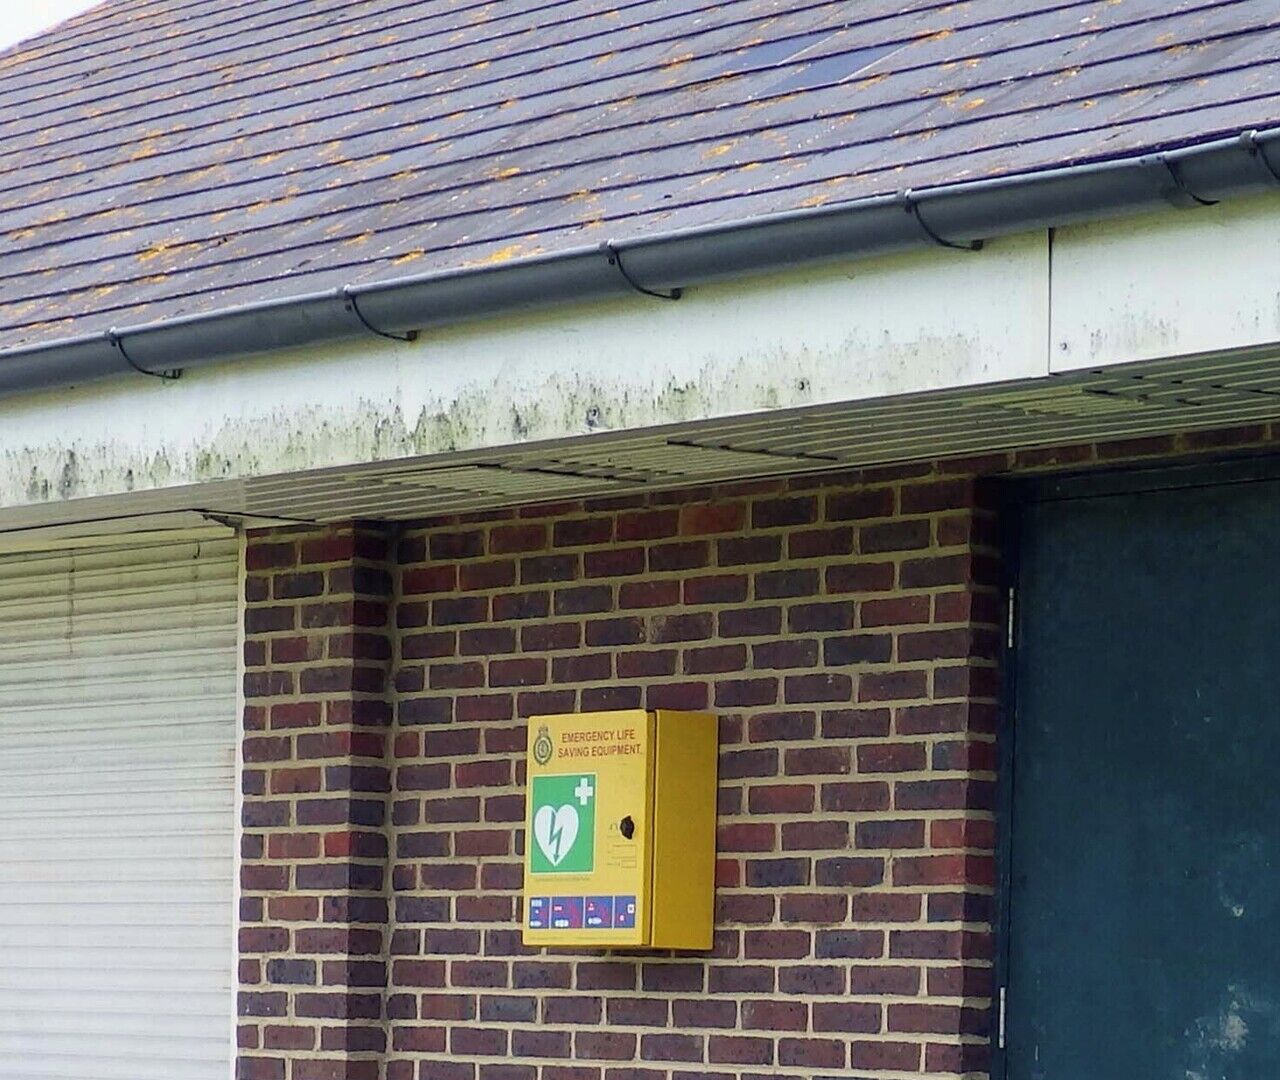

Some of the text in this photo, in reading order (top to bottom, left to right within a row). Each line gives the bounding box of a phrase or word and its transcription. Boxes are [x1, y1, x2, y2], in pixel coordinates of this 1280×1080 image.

[562, 729, 635, 743] EMERGENCY LIFE
[558, 744, 641, 758] SAVING EQUIPMENT
